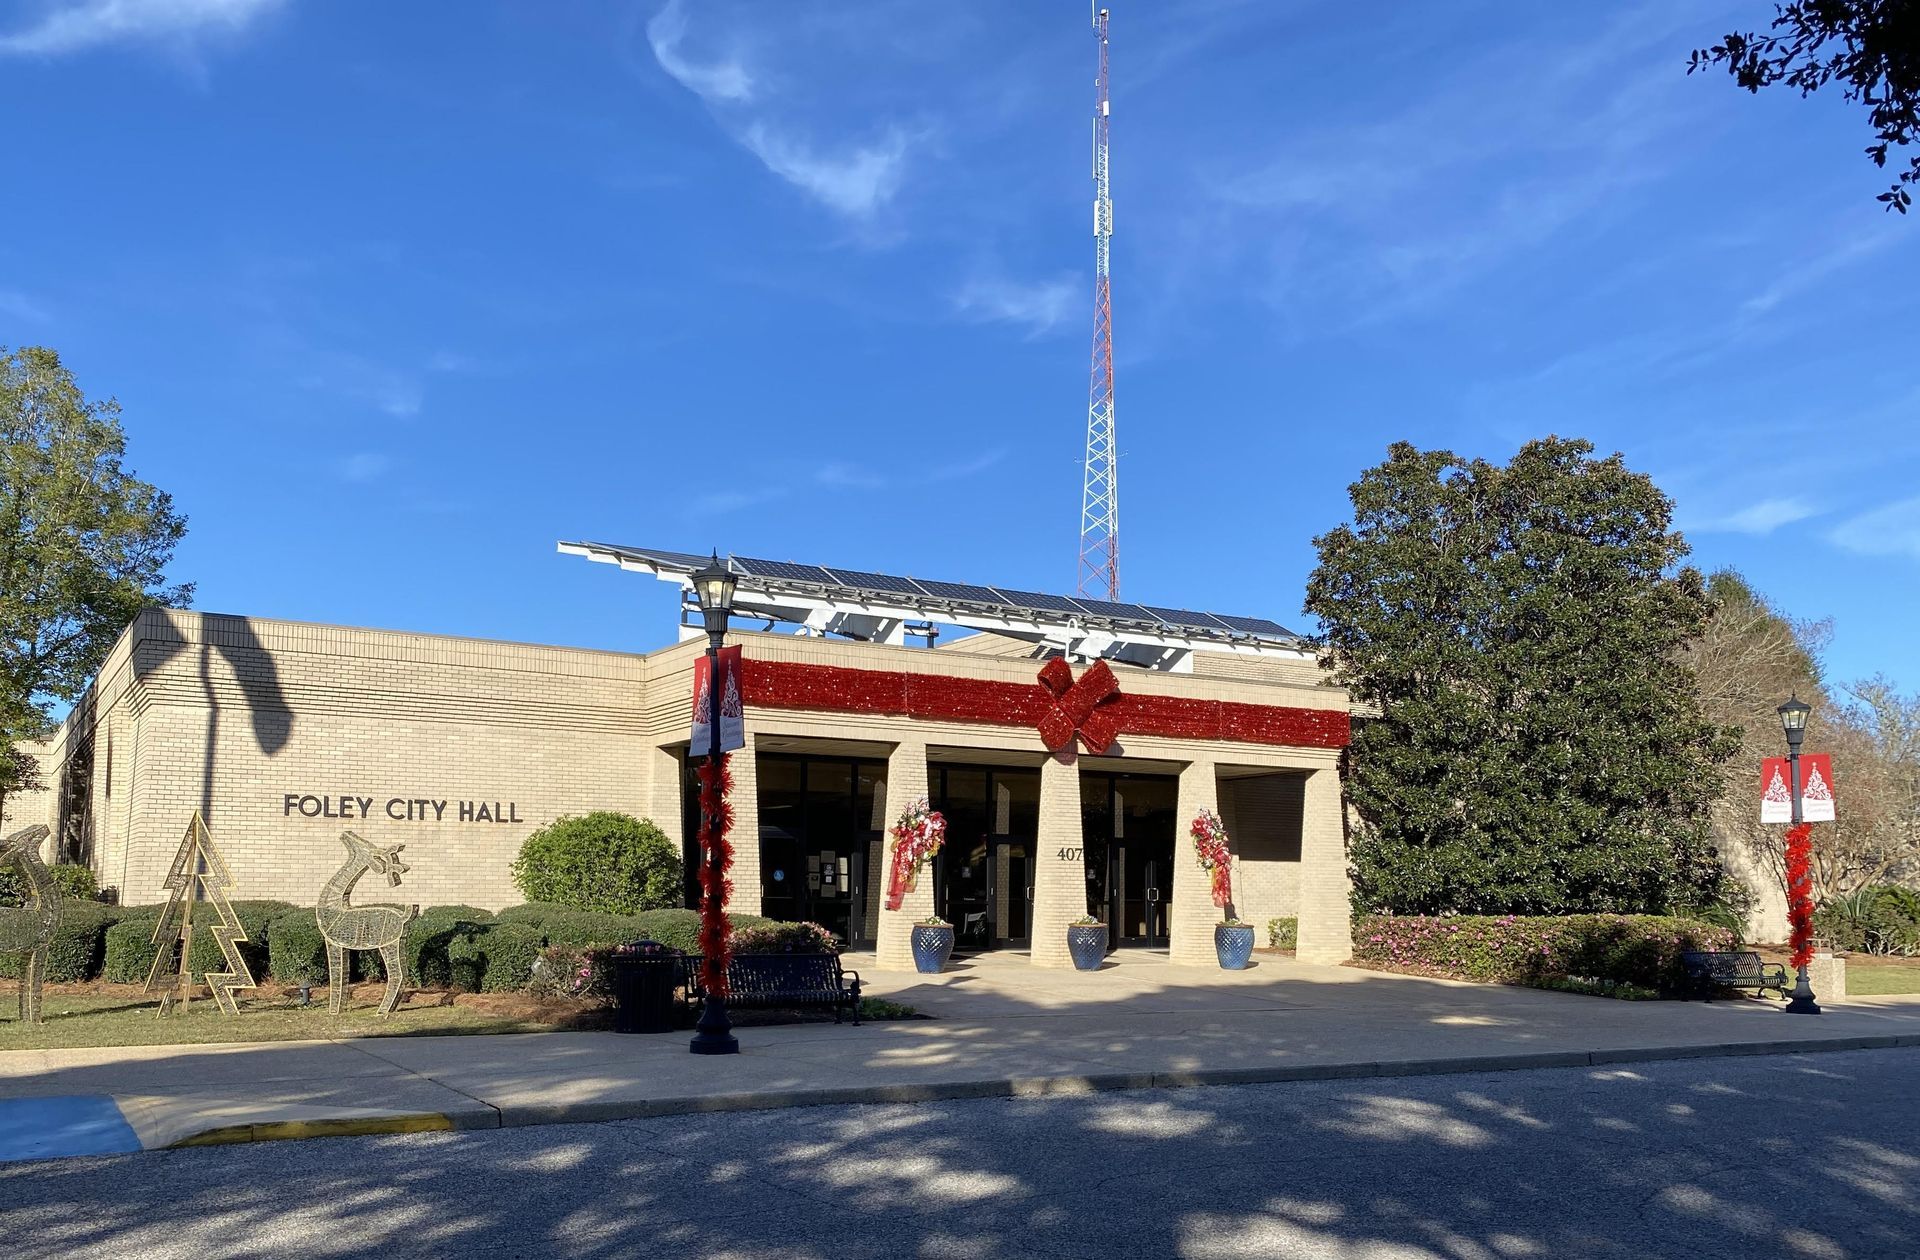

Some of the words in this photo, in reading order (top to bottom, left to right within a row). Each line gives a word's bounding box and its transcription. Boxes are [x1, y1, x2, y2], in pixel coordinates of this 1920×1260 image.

[284, 794, 373, 818] FOLEY
[386, 798, 447, 821] CITY
[459, 801, 523, 823] HALL
[1057, 847, 1083, 861] 407
